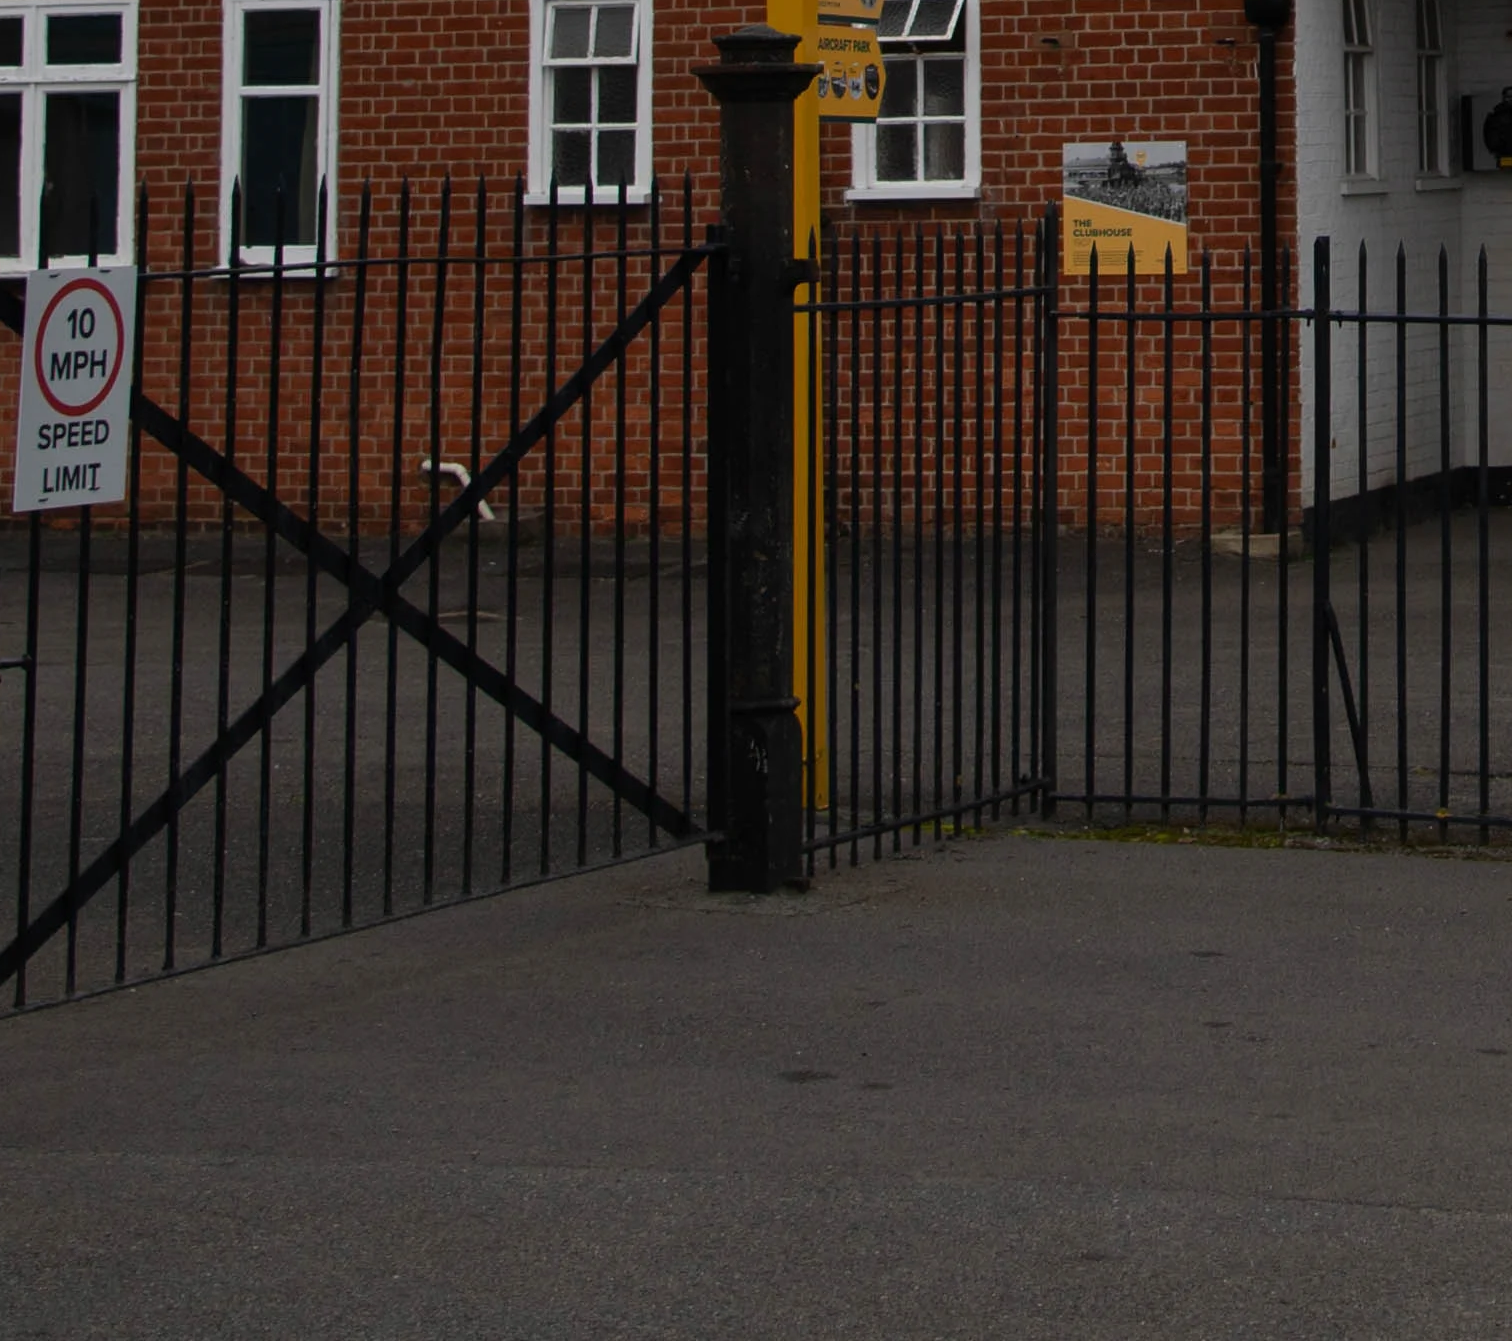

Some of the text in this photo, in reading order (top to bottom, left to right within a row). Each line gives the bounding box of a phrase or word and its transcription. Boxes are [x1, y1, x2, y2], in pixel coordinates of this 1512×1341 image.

[817, 36, 871, 54] AIRCRAFT PARK
[1072, 219, 1092, 228] THE
[1073, 228, 1133, 238] CLUBHOUSE
[67, 307, 96, 340] 10
[49, 349, 107, 382] MPH
[37, 418, 110, 450] SPEED
[42, 462, 102, 494] LIMIT
